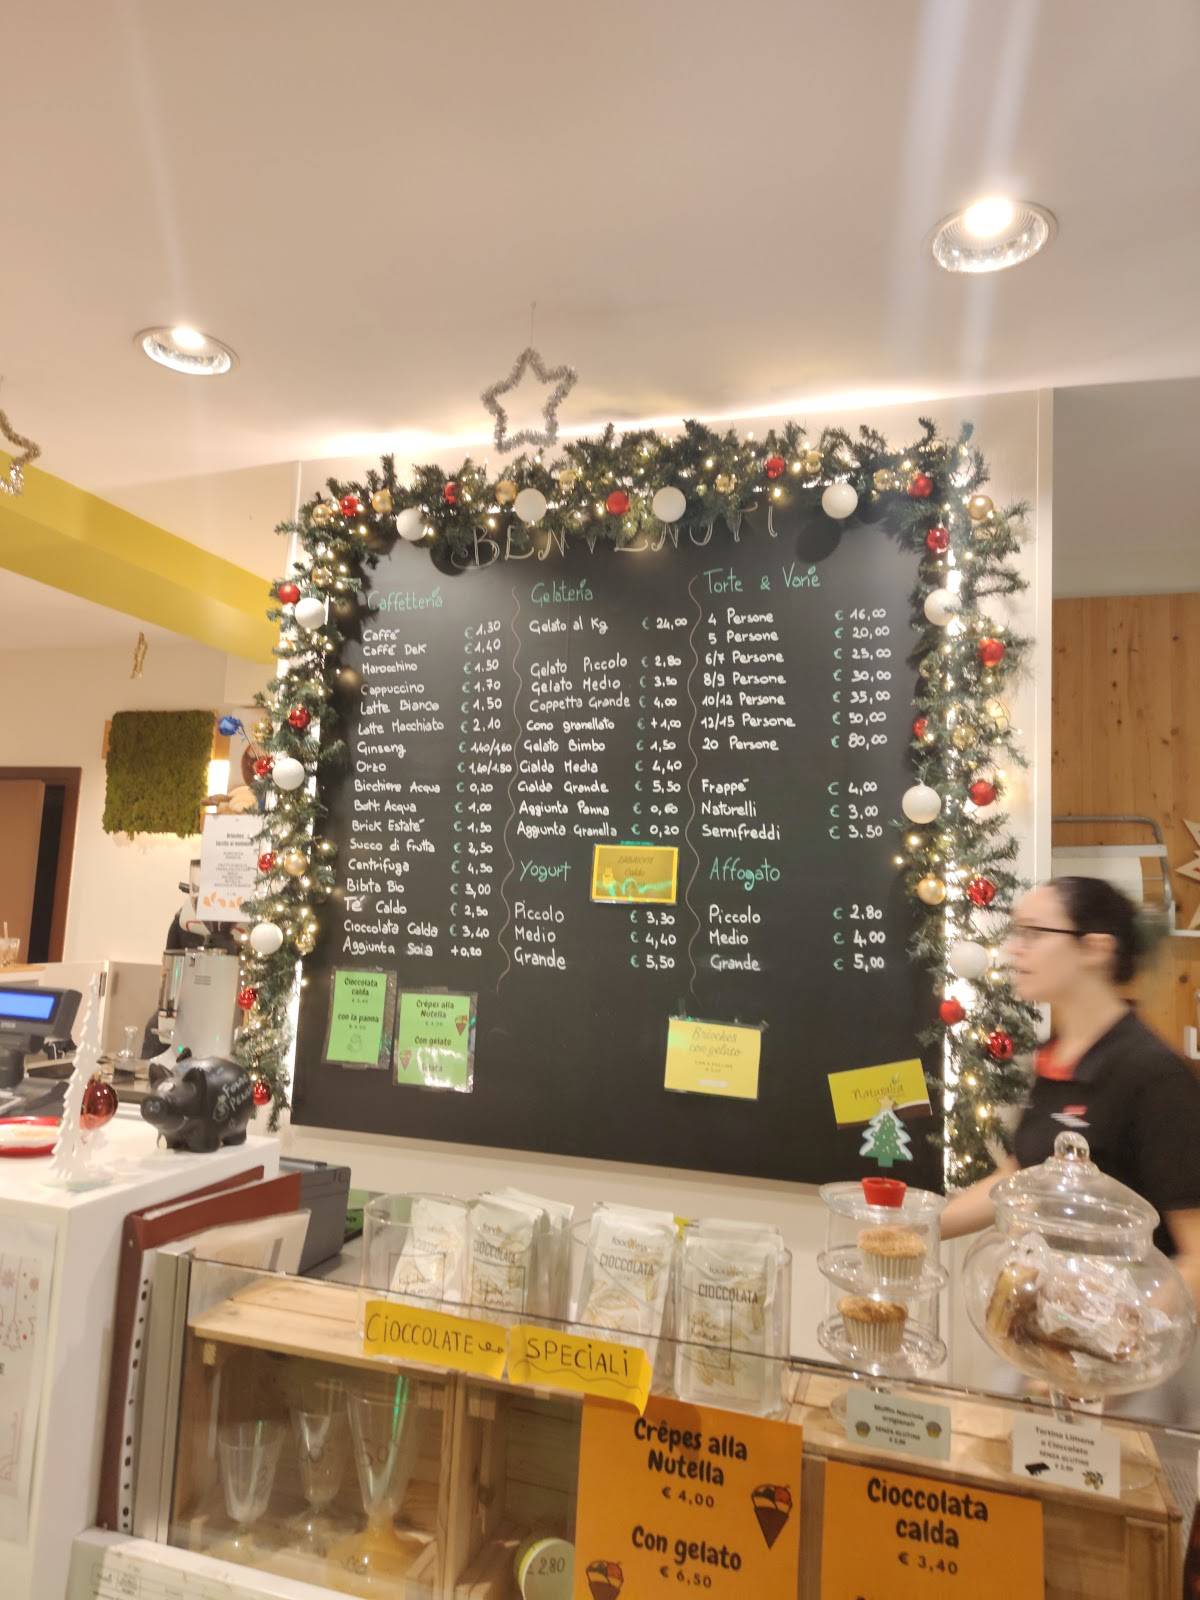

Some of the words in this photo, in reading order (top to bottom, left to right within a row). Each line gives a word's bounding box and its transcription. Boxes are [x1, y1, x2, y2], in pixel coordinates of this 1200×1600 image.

[703, 567, 743, 593] Torte
[760, 576, 771, 590] &
[368, 586, 443, 612] Caffetteria
[531, 579, 593, 607] Gelateria
[529, 618, 566, 635] Gelato
[573, 616, 583, 630] al
[591, 617, 609, 635] Kg
[656, 617, 688, 630] 24,00
[708, 613, 716, 625] 4
[727, 607, 774, 625] Persone
[850, 608, 887, 622] 16,00
[708, 632, 717, 645] 5
[727, 630, 779, 643] Persone
[852, 625, 890, 640] 20,00
[530, 658, 567, 679] Gelato
[583, 652, 628, 673] Piccolo
[655, 655, 682, 668] 2,80
[705, 650, 725, 666] 6/7
[732, 650, 784, 664] Persone
[852, 647, 892, 660] 25,00
[362, 660, 418, 675] Marocchino
[531, 677, 573, 696] Gelato
[583, 674, 621, 692] Medio
[703, 671, 725, 688] 8/9
[733, 671, 786, 685] Persone
[851, 669, 892, 683] 30,00
[361, 681, 424, 697] Cappuccino
[739, 692, 786, 705] Persone
[850, 690, 891, 705] 35,00
[361, 700, 390, 715] Latte
[400, 699, 439, 711] Bianco
[530, 696, 583, 713] Coppetta
[589, 692, 631, 709] Grande
[653, 697, 678, 709] 4,00
[358, 722, 384, 735] Latte
[392, 717, 444, 733] Macchiato
[526, 720, 554, 731] Cono
[563, 717, 615, 733] granellato
[660, 718, 682, 731] 1,00
[701, 713, 735, 730] 12/15
[742, 712, 796, 727] Persone
[849, 711, 887, 726] 50,00
[357, 741, 406, 758] Ginseng
[523, 738, 559, 752] Gelato
[568, 738, 606, 751] Bimbo
[650, 739, 676, 752] 1,50
[702, 738, 719, 750] 20
[730, 735, 779, 751] Persone
[848, 732, 887, 751] 80,00
[356, 760, 386, 773] Orzo
[519, 760, 555, 773] Cialda
[564, 759, 598, 773] Media
[652, 760, 682, 775] 4,40
[354, 779, 401, 792] Bicchiere
[410, 781, 440, 794] Acqua
[517, 780, 553, 792] Cialda
[563, 781, 609, 793] Grande
[652, 780, 681, 794] 5,50
[848, 781, 877, 796] 4,00
[385, 800, 417, 815] Acqua
[468, 802, 492, 814] 1,00
[519, 800, 568, 816] Aggiunta
[577, 800, 610, 816] Panna
[352, 820, 382, 832] Brick
[517, 821, 567, 839] Aggiunta
[573, 822, 617, 837] Granella
[649, 824, 680, 838] 0,20
[702, 823, 780, 840] Semifreddi
[350, 838, 383, 851] Succo
[390, 838, 399, 851] di
[348, 857, 410, 876] Centrifuga
[520, 860, 571, 882] Yogurt
[710, 857, 781, 891] Affogato
[347, 878, 381, 893] Bibita
[387, 880, 404, 892] Bio
[376, 899, 407, 914] Caldo
[514, 900, 565, 923] Piccolo
[647, 911, 675, 926] 3,30
[709, 904, 761, 924] Piccolo
[344, 919, 399, 934] Cioccolata
[408, 922, 438, 937] Calda
[462, 925, 490, 939] 3,40
[514, 926, 556, 943] Medio
[645, 933, 677, 949] 4,40
[709, 928, 749, 946] Medio
[853, 929, 886, 948] 4,00
[343, 936, 395, 955] Aggiunta
[407, 942, 433, 956] Soia
[514, 946, 567, 970] Grande
[646, 954, 675, 969] 5,50
[710, 952, 761, 972] Grande
[853, 953, 885, 973] 5,00
[600, 1253, 655, 1276] CIOCCOLATA
[699, 1283, 759, 1304] CIOCCOLATA
[634, 1417, 702, 1451] Crêpes
[708, 1435, 748, 1460] alla
[647, 1450, 724, 1486] Nutella
[661, 1486, 671, 1499] €
[678, 1490, 715, 1508] 4,00
[867, 1477, 989, 1522] Cioccolata
[896, 1517, 960, 1549] calda
[631, 1525, 668, 1554] Con
[674, 1538, 742, 1571] gelato
[898, 1552, 909, 1566] €
[918, 1555, 958, 1576] 3,40
[659, 1565, 669, 1578] €
[676, 1570, 712, 1589] 6,50
